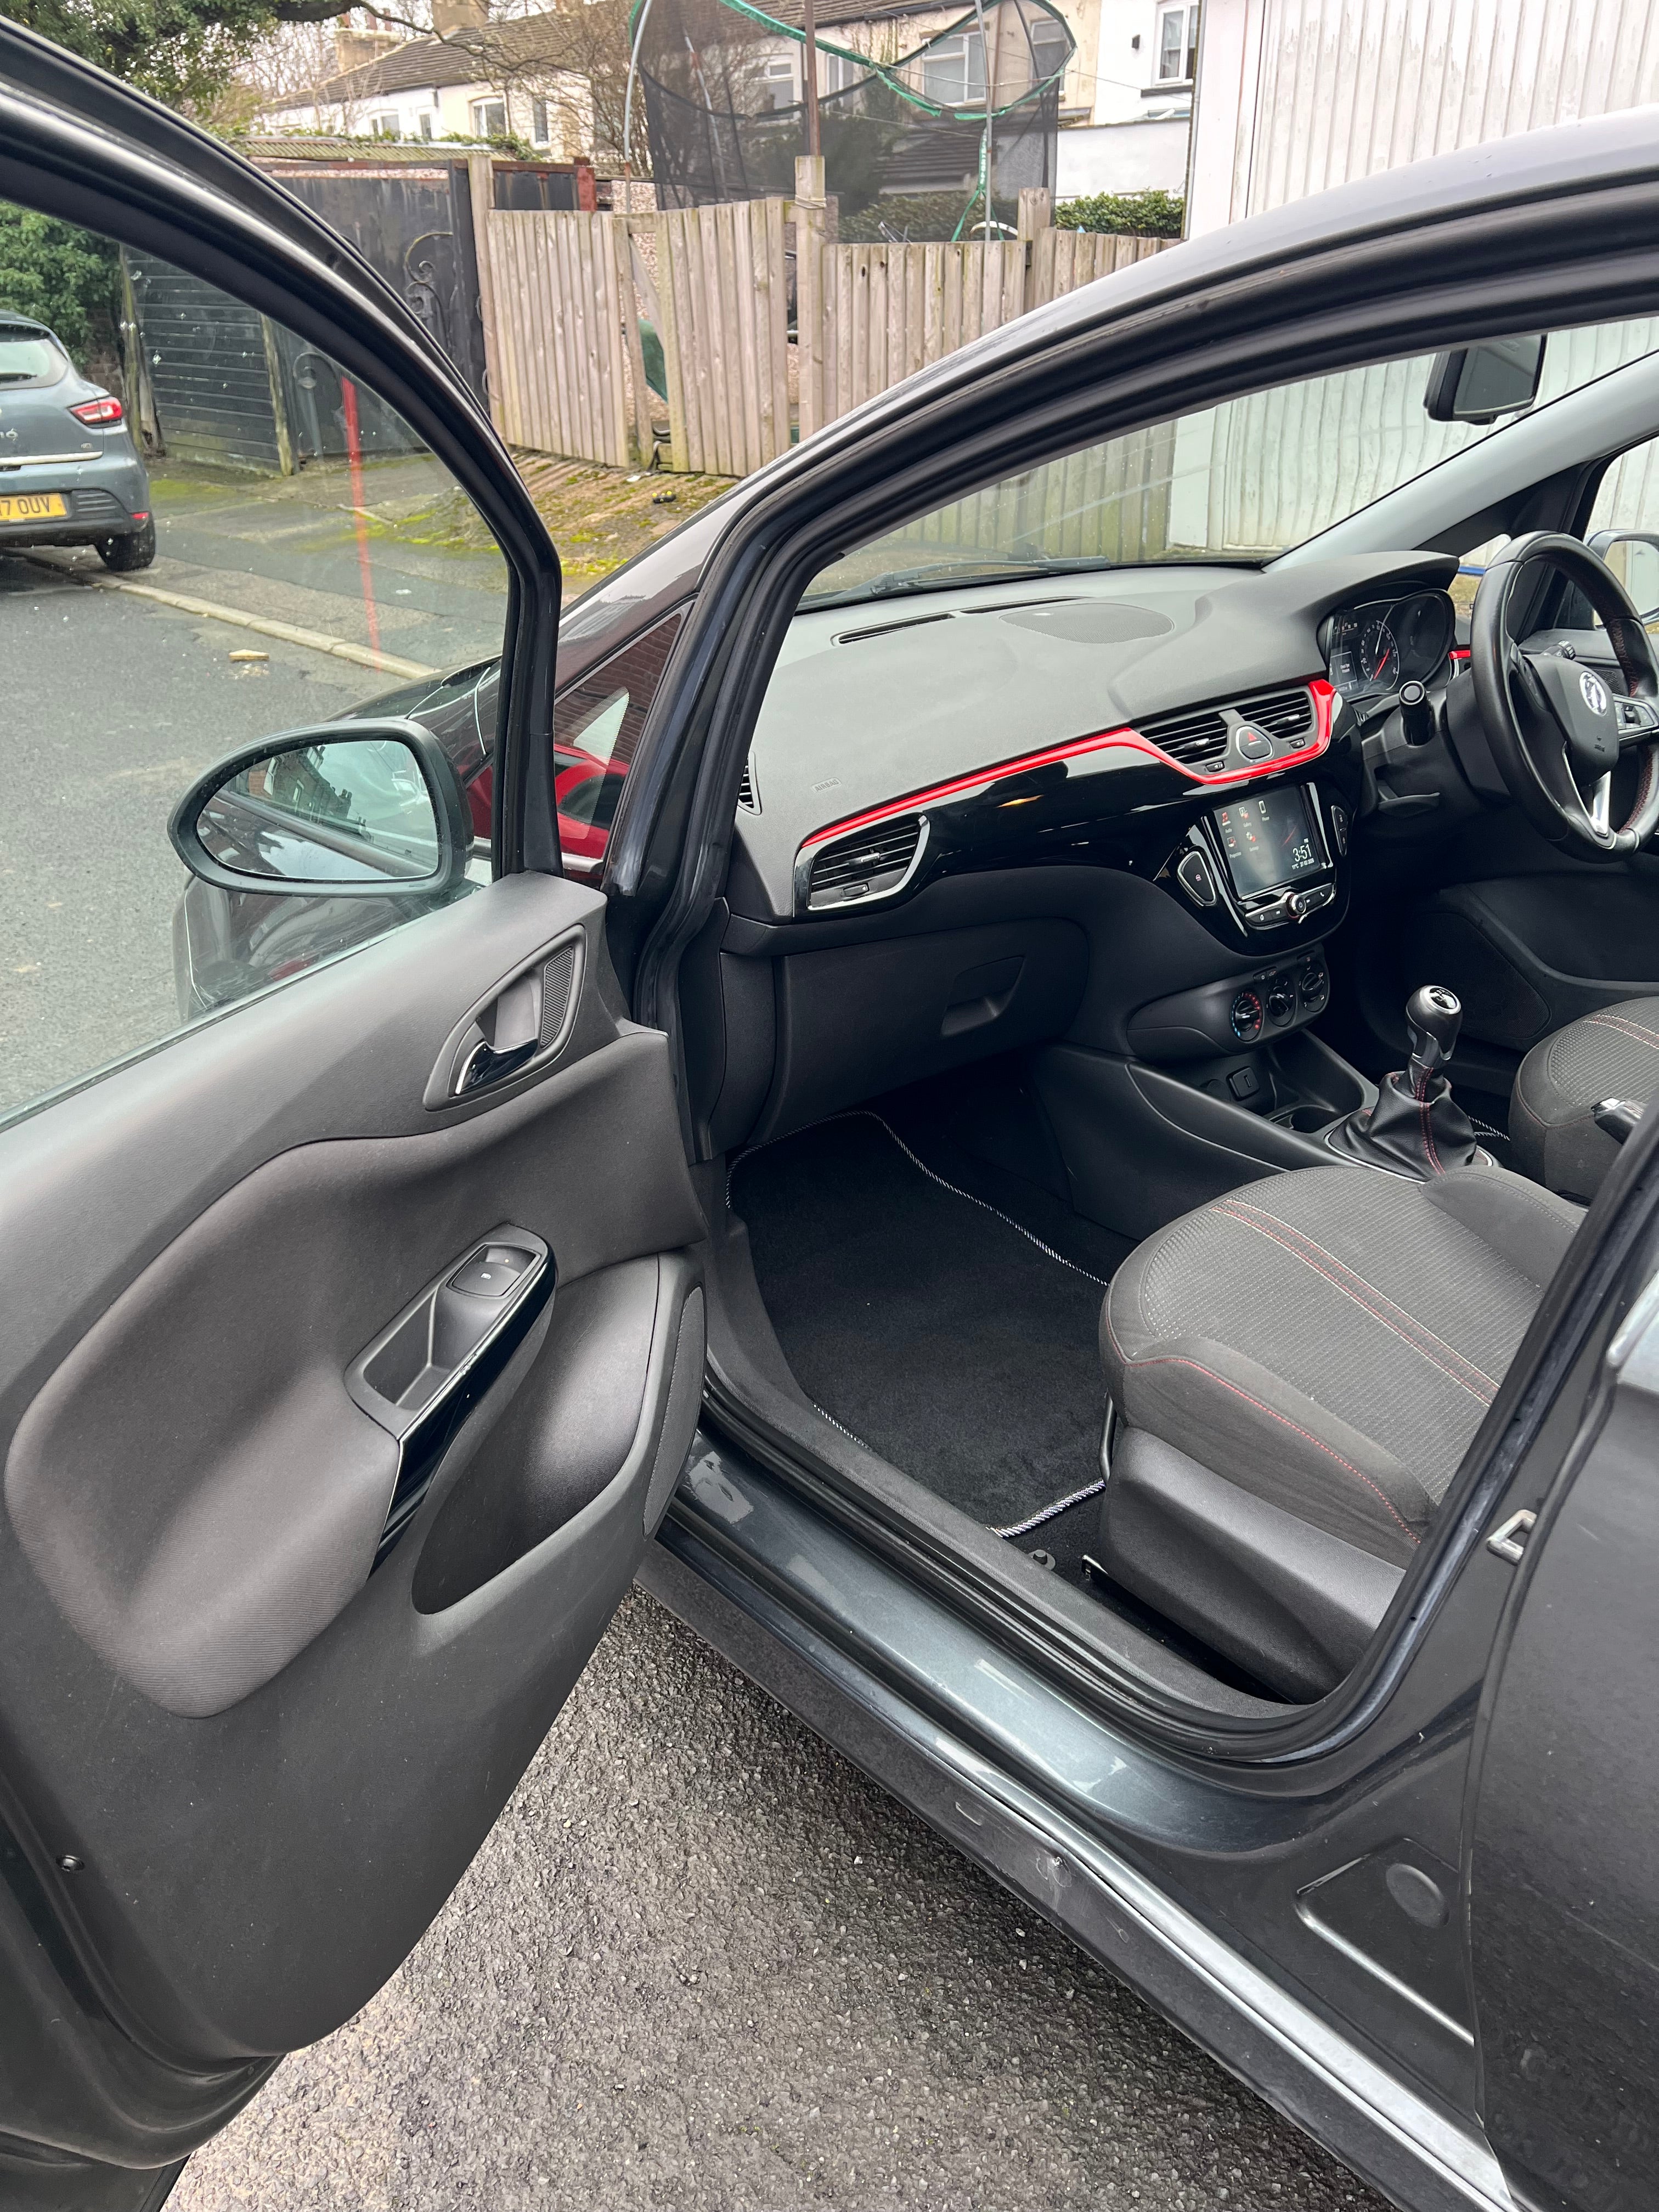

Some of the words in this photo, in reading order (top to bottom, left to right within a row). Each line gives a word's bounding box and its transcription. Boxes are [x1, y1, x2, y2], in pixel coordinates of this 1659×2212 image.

[18, 496, 49, 514] OUV
[815, 780, 839, 792] AIRBAG
[1293, 844, 1312, 862] 3:51
